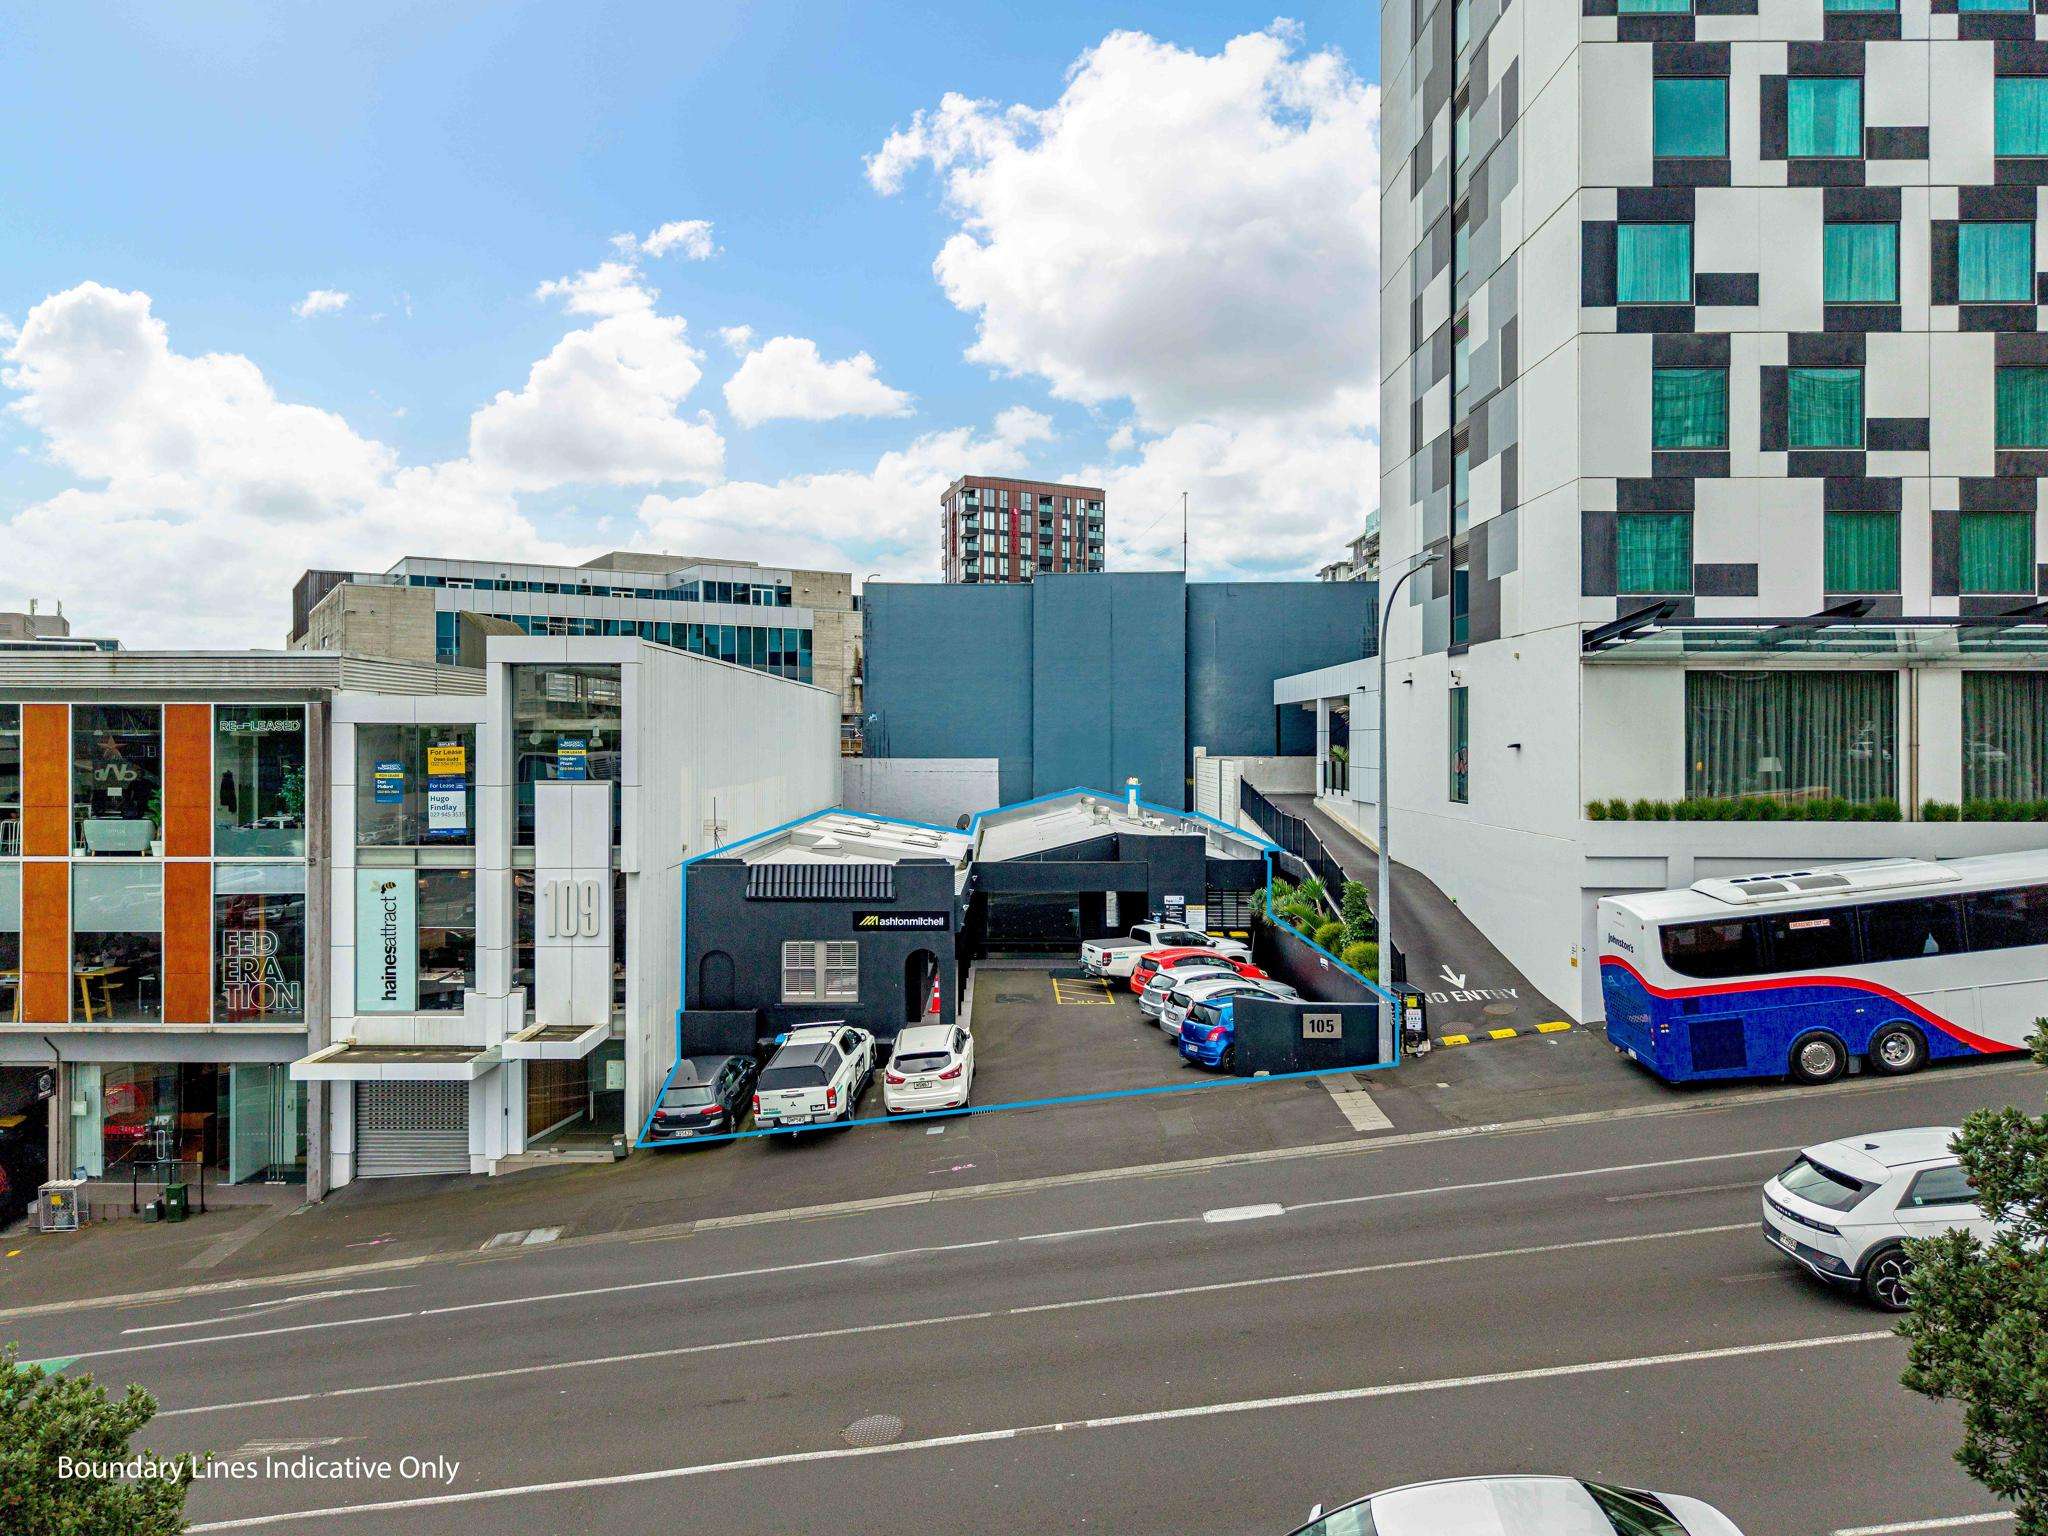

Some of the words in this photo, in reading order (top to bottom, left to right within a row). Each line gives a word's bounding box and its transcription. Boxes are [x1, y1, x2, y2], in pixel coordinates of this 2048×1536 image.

[430, 795, 450, 803] Hugo
[430, 804, 457, 812] Findlay
[544, 880, 599, 937] 109
[879, 916, 944, 926] ashtonmitchell
[222, 930, 280, 957] FED
[380, 896, 397, 1001] hainesattract
[1607, 932, 1634, 953] Johnston's
[222, 957, 284, 982] ERA
[222, 981, 300, 1010] TION
[1308, 1019, 1335, 1033] 105
